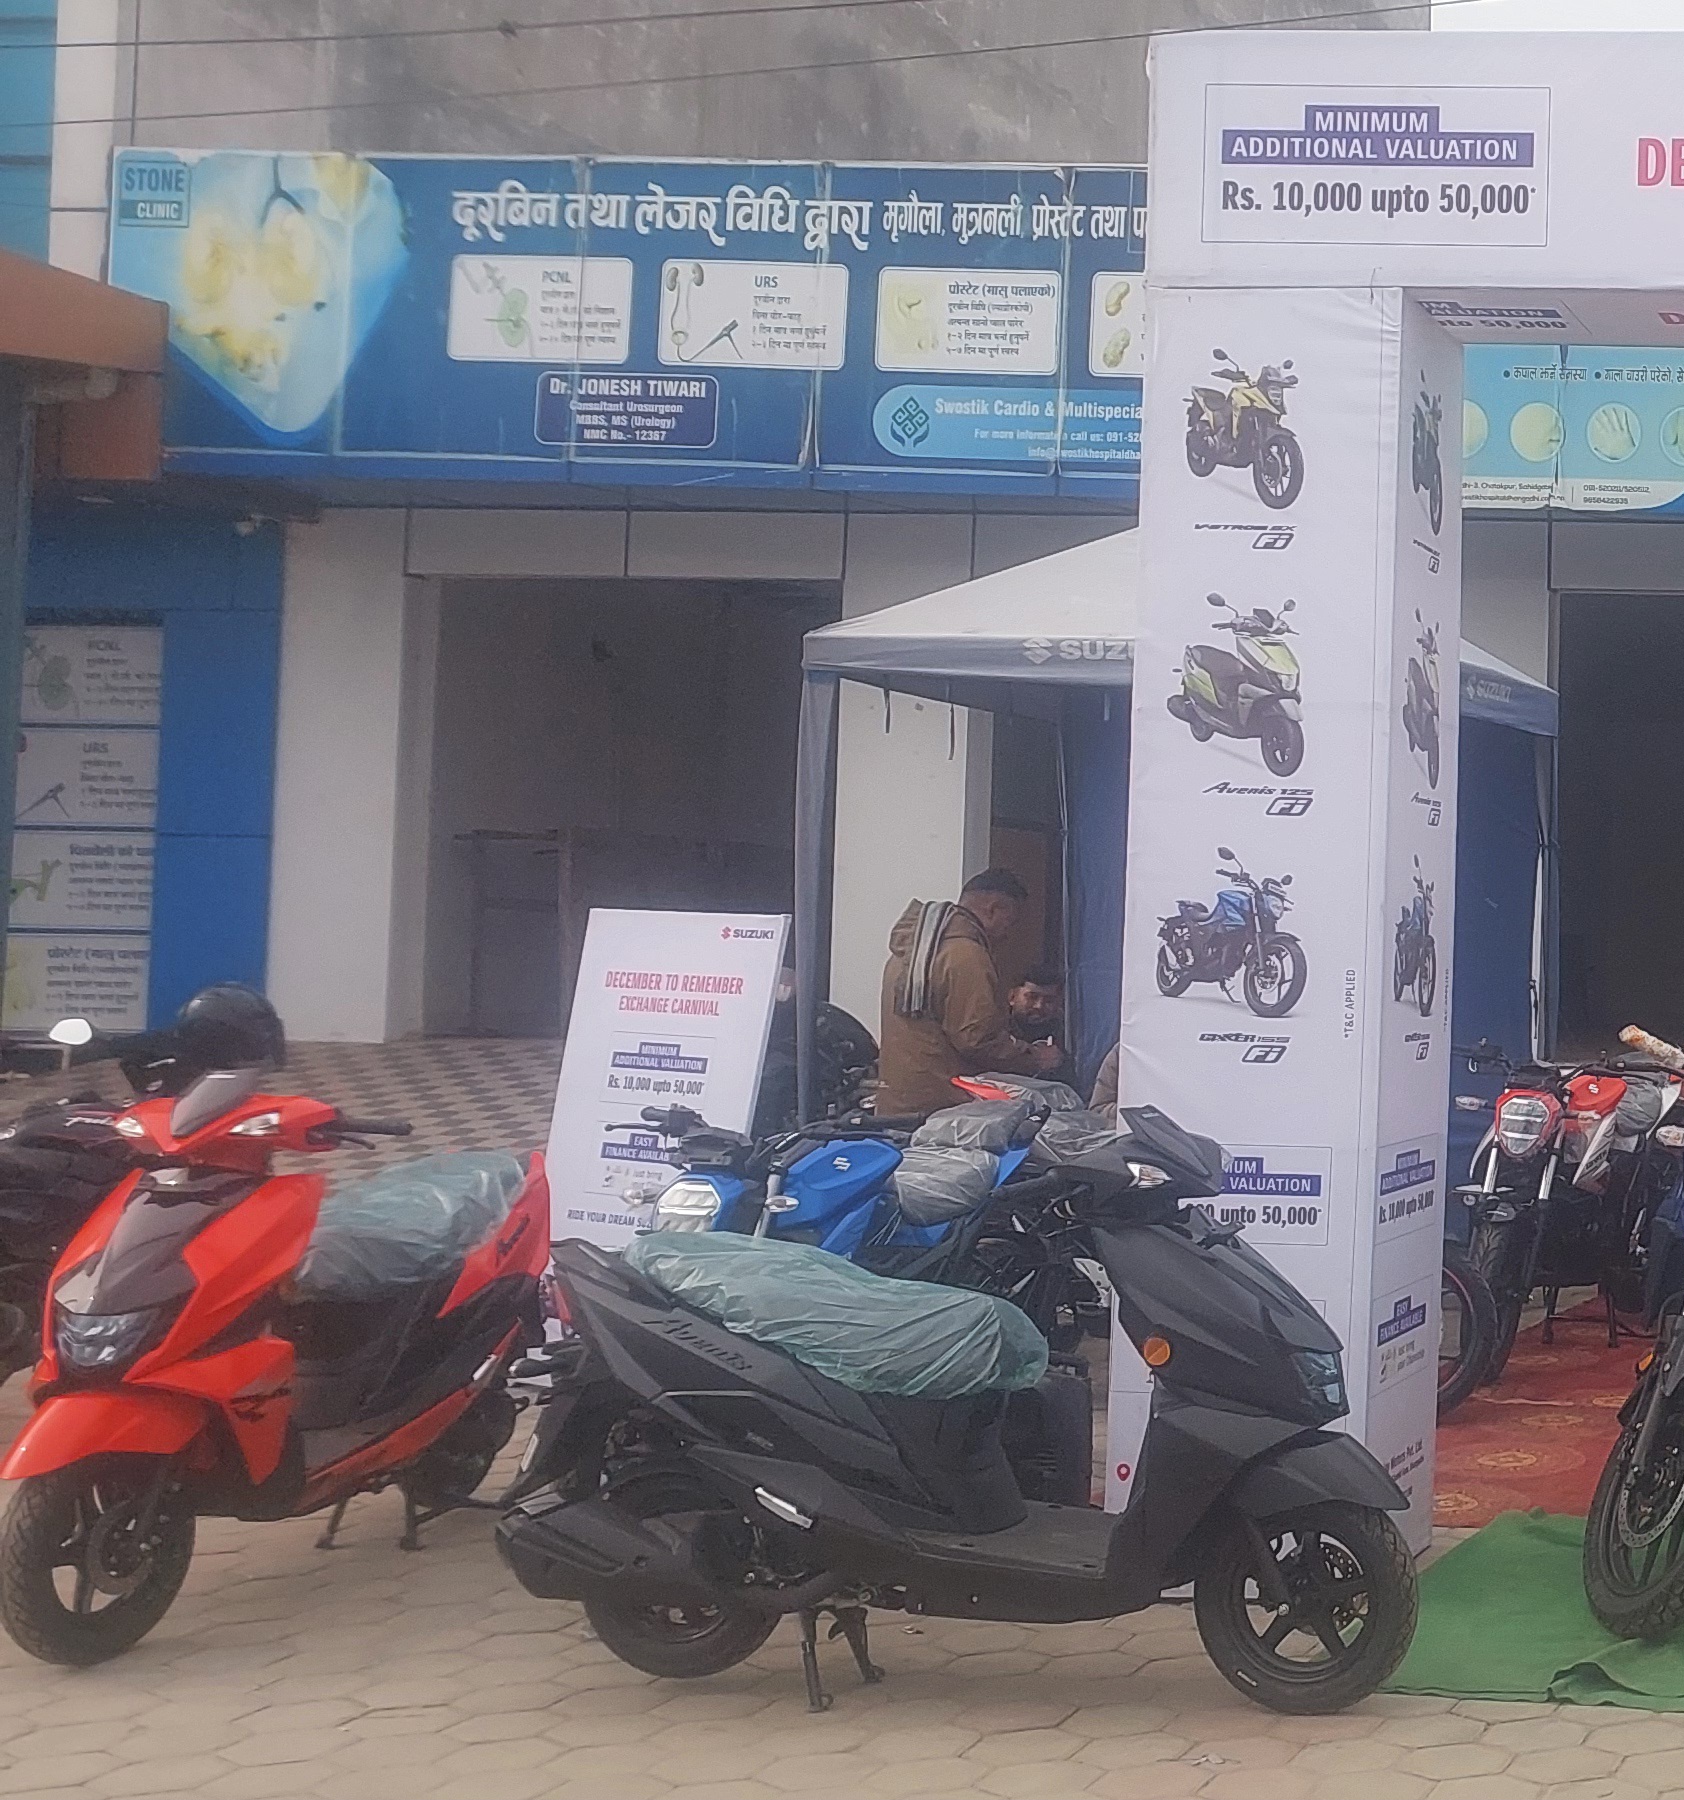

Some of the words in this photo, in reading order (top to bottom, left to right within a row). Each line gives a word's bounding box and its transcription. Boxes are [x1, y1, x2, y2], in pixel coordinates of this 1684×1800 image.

[1314, 110, 1429, 133] MINIMUM
[1231, 136, 1378, 160] ADDITIONAL
[1386, 137, 1518, 161] VALUATION
[124, 168, 186, 193] STONE
[1221, 180, 1262, 212] Rs.
[1272, 181, 1362, 217] 10,000
[1371, 183, 1430, 218] upto
[136, 202, 181, 219] CLINIC
[451, 179, 560, 242] दूरबिन
[564, 189, 629, 231] तथा
[634, 181, 725, 246] लेजर
[726, 184, 799, 235] विधि
[804, 198, 874, 251] द्वारा
[1090, 205, 1128, 240] तथा
[542, 271, 573, 283] PCNL
[754, 275, 779, 289] URS
[1430, 308, 1545, 318] ALUATION
[550, 377, 572, 395] Dr.
[578, 379, 642, 397] JONESH
[646, 380, 707, 398] TIWARI
[569, 400, 624, 413] Consultant
[626, 401, 684, 415] Urosurgeon
[934, 397, 990, 416] Swostik
[993, 399, 1040, 417] Cardio
[1044, 400, 1055, 416] &
[611, 415, 628, 427] MS
[630, 416, 676, 430] (Urology)
[583, 429, 607, 441] NMC
[974, 428, 990, 439] For
[991, 430, 1014, 439] more
[1070, 431, 1088, 441] call
[1254, 534, 1293, 549] Fi
[1202, 781, 1273, 796] Avenis
[1277, 787, 1314, 796] 125
[1268, 798, 1312, 815] Fi
[732, 928, 775, 940] SUZUKI
[605, 971, 662, 992] DECEMBER
[665, 973, 678, 991] TO
[681, 974, 743, 995] REMEMBER
[1344, 968, 1356, 1008] APPLIED
[618, 995, 668, 1013] EXCHANGE
[671, 998, 720, 1017] CARNIVAL
[641, 1043, 678, 1056] MINIMUM
[1244, 1046, 1286, 1062] Fi
[613, 1055, 660, 1069] ADDITIONAL
[660, 1057, 703, 1071] VALUATION
[607, 1074, 620, 1089] Rs.
[622, 1076, 651, 1094] 10,000
[633, 1136, 654, 1148] EASY
[1229, 1177, 1311, 1193] VALUATION
[567, 1208, 585, 1221] RIDE
[586, 1210, 607, 1224] YOUR
[608, 1212, 636, 1226] DREAM
